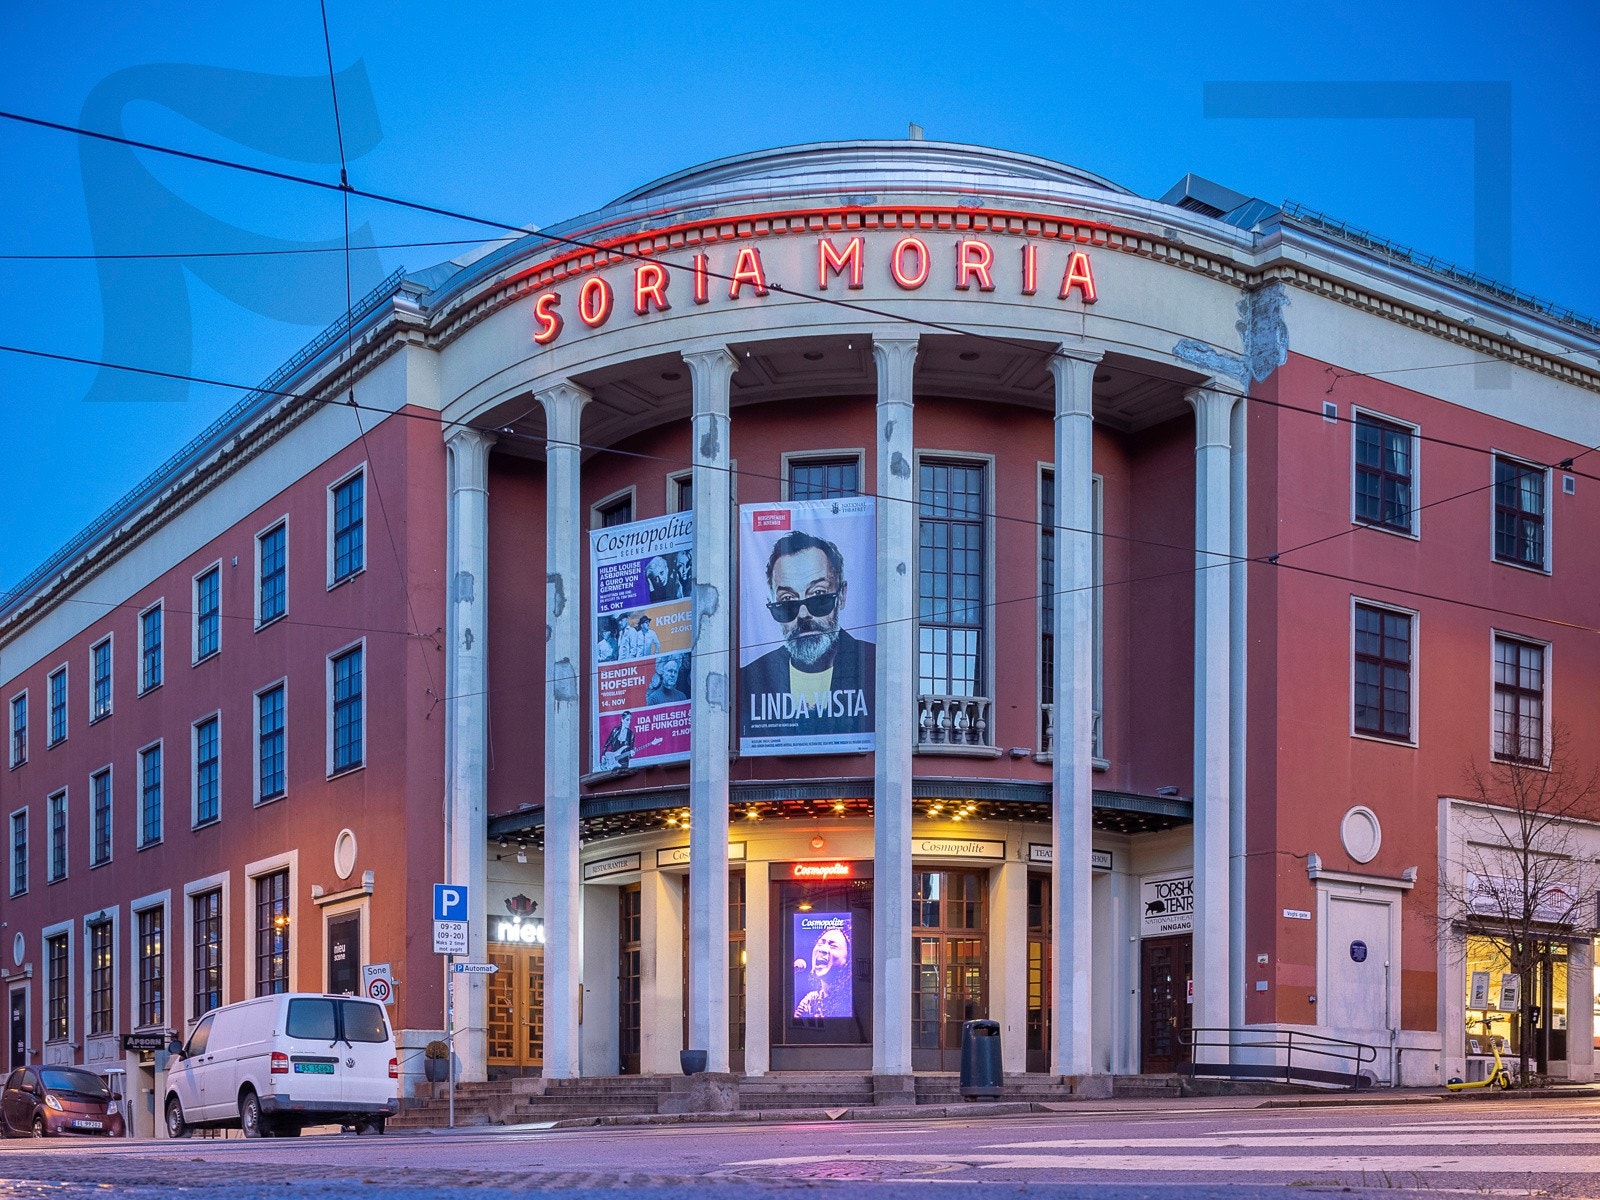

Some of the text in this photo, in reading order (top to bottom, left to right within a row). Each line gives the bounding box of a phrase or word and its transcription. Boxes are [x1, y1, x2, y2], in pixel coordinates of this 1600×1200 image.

[533, 236, 1099, 345] SORIA MORIA
[596, 516, 693, 552] Cosmopolite
[620, 541, 674, 558] SCENE OSLO
[599, 561, 641, 575] HILDE LOUISE
[600, 567, 642, 580] ASBJØRNSEN
[600, 582, 634, 593] GERMETEN
[605, 577, 624, 586] GURO
[610, 601, 624, 609] OKT
[655, 611, 692, 626] KROKE
[600, 666, 638, 680] BENDIK
[601, 676, 646, 690] HOFSETH
[611, 698, 626, 706] NOV
[750, 689, 868, 721] LINDA VISTA
[637, 716, 651, 725] IDA
[652, 710, 687, 722] NIELSEN
[634, 724, 650, 733] THE
[921, 841, 985, 854] Cosmopolite
[1034, 849, 1052, 858] TEAT
[592, 860, 629, 874] RESTAURANTER
[794, 862, 849, 879] Cosmopolite
[1154, 880, 1193, 899] TORSH
[442, 889, 460, 916] P
[1164, 895, 1193, 913] TEATR
[801, 917, 844, 929] Cosmopolite
[1144, 914, 1193, 924] NATIONALTHEAT
[1160, 921, 1191, 931] INNGANG
[367, 967, 387, 975] Sone
[372, 984, 387, 997] 30
